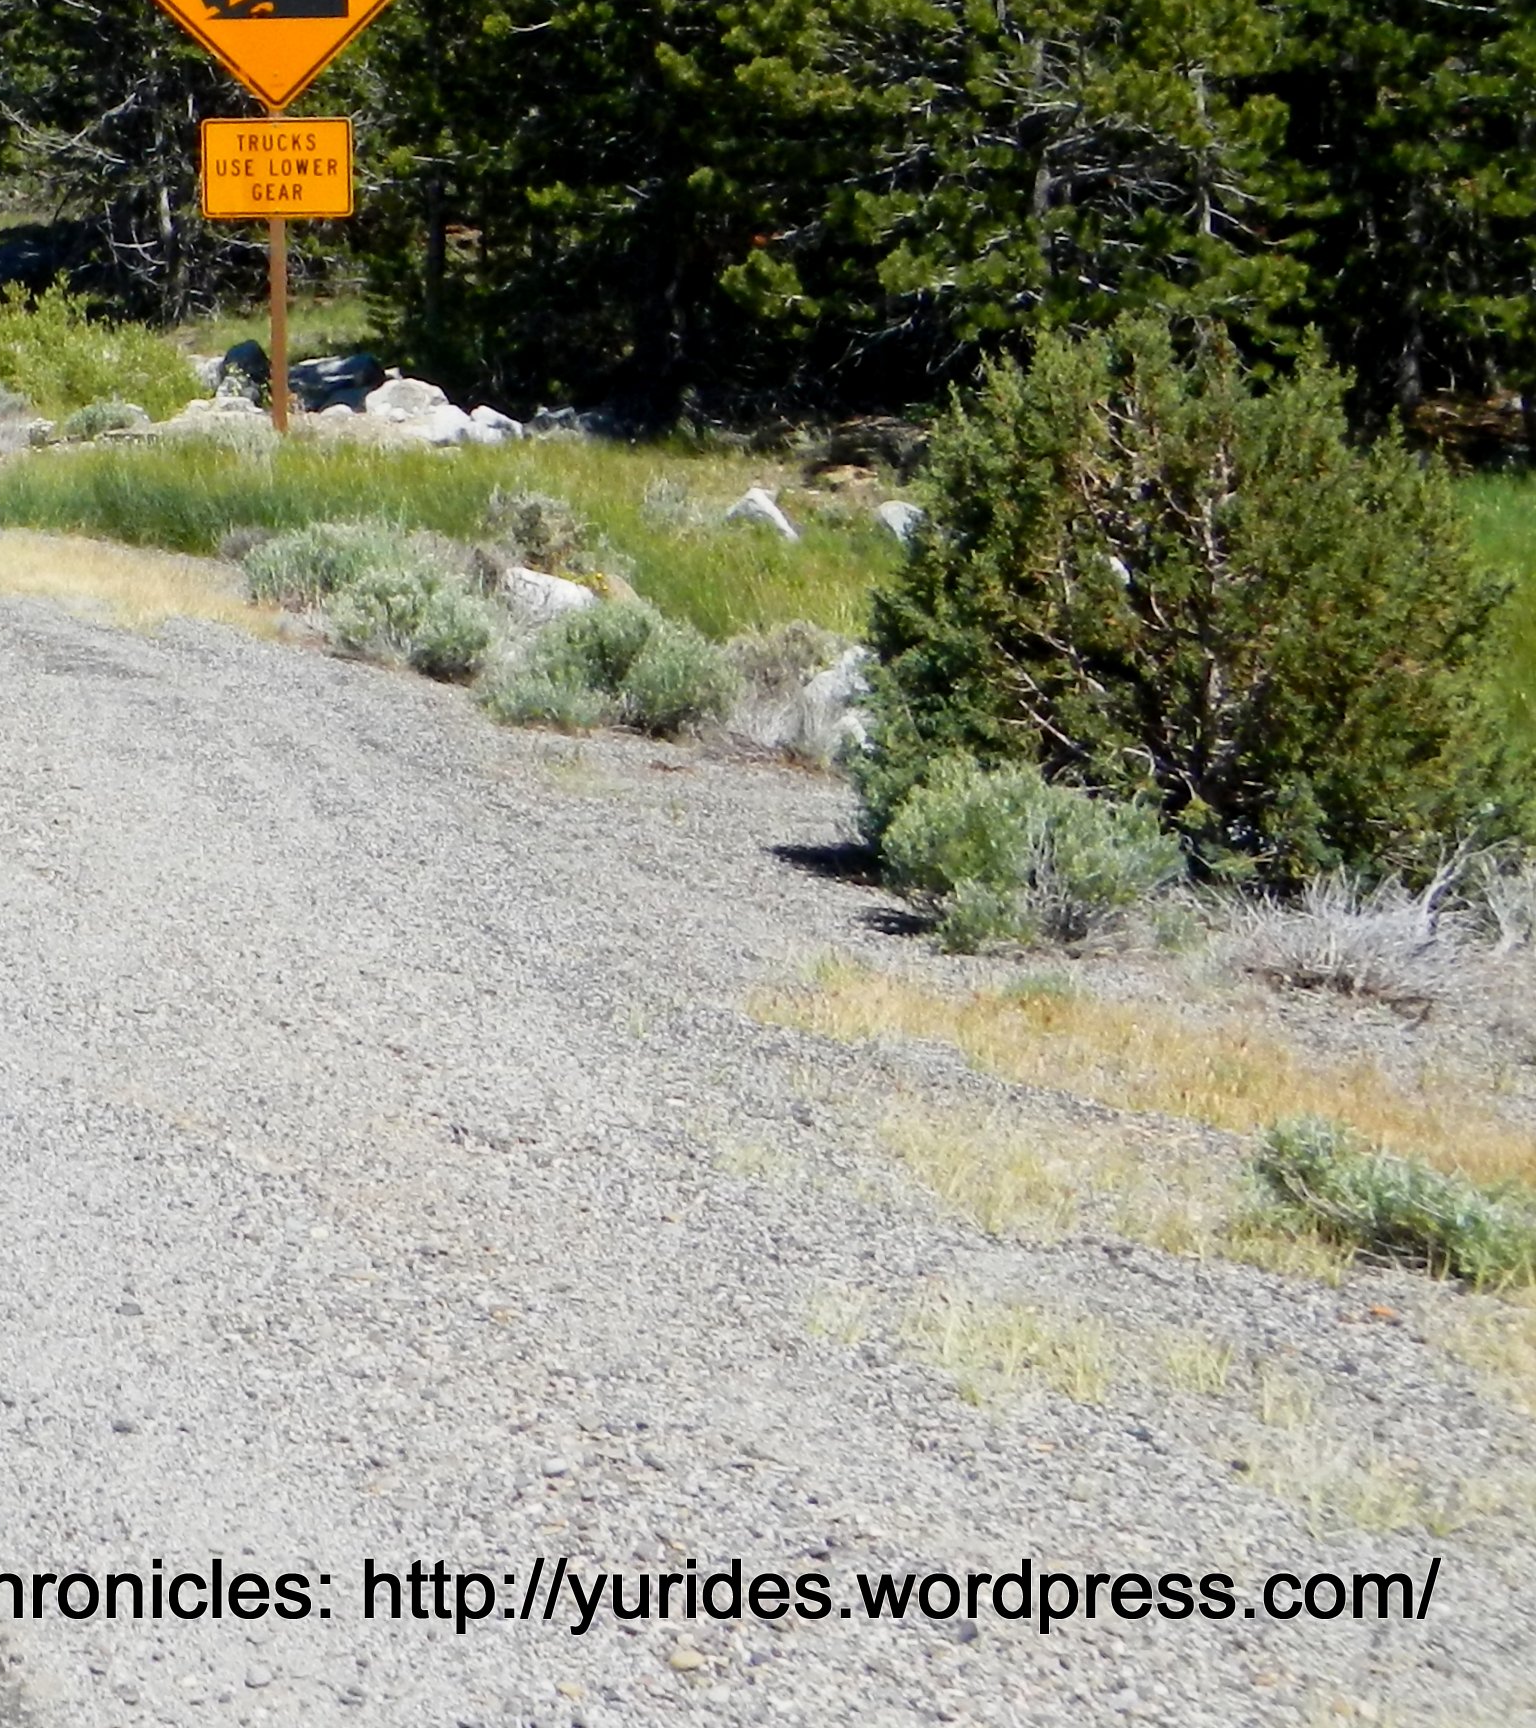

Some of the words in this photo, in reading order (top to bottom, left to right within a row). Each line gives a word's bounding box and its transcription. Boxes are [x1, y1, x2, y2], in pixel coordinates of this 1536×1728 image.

[237, 134, 317, 151] TRUCKS
[216, 159, 253, 176] USE
[269, 159, 338, 176] LOWER
[252, 183, 303, 201] GEAR
